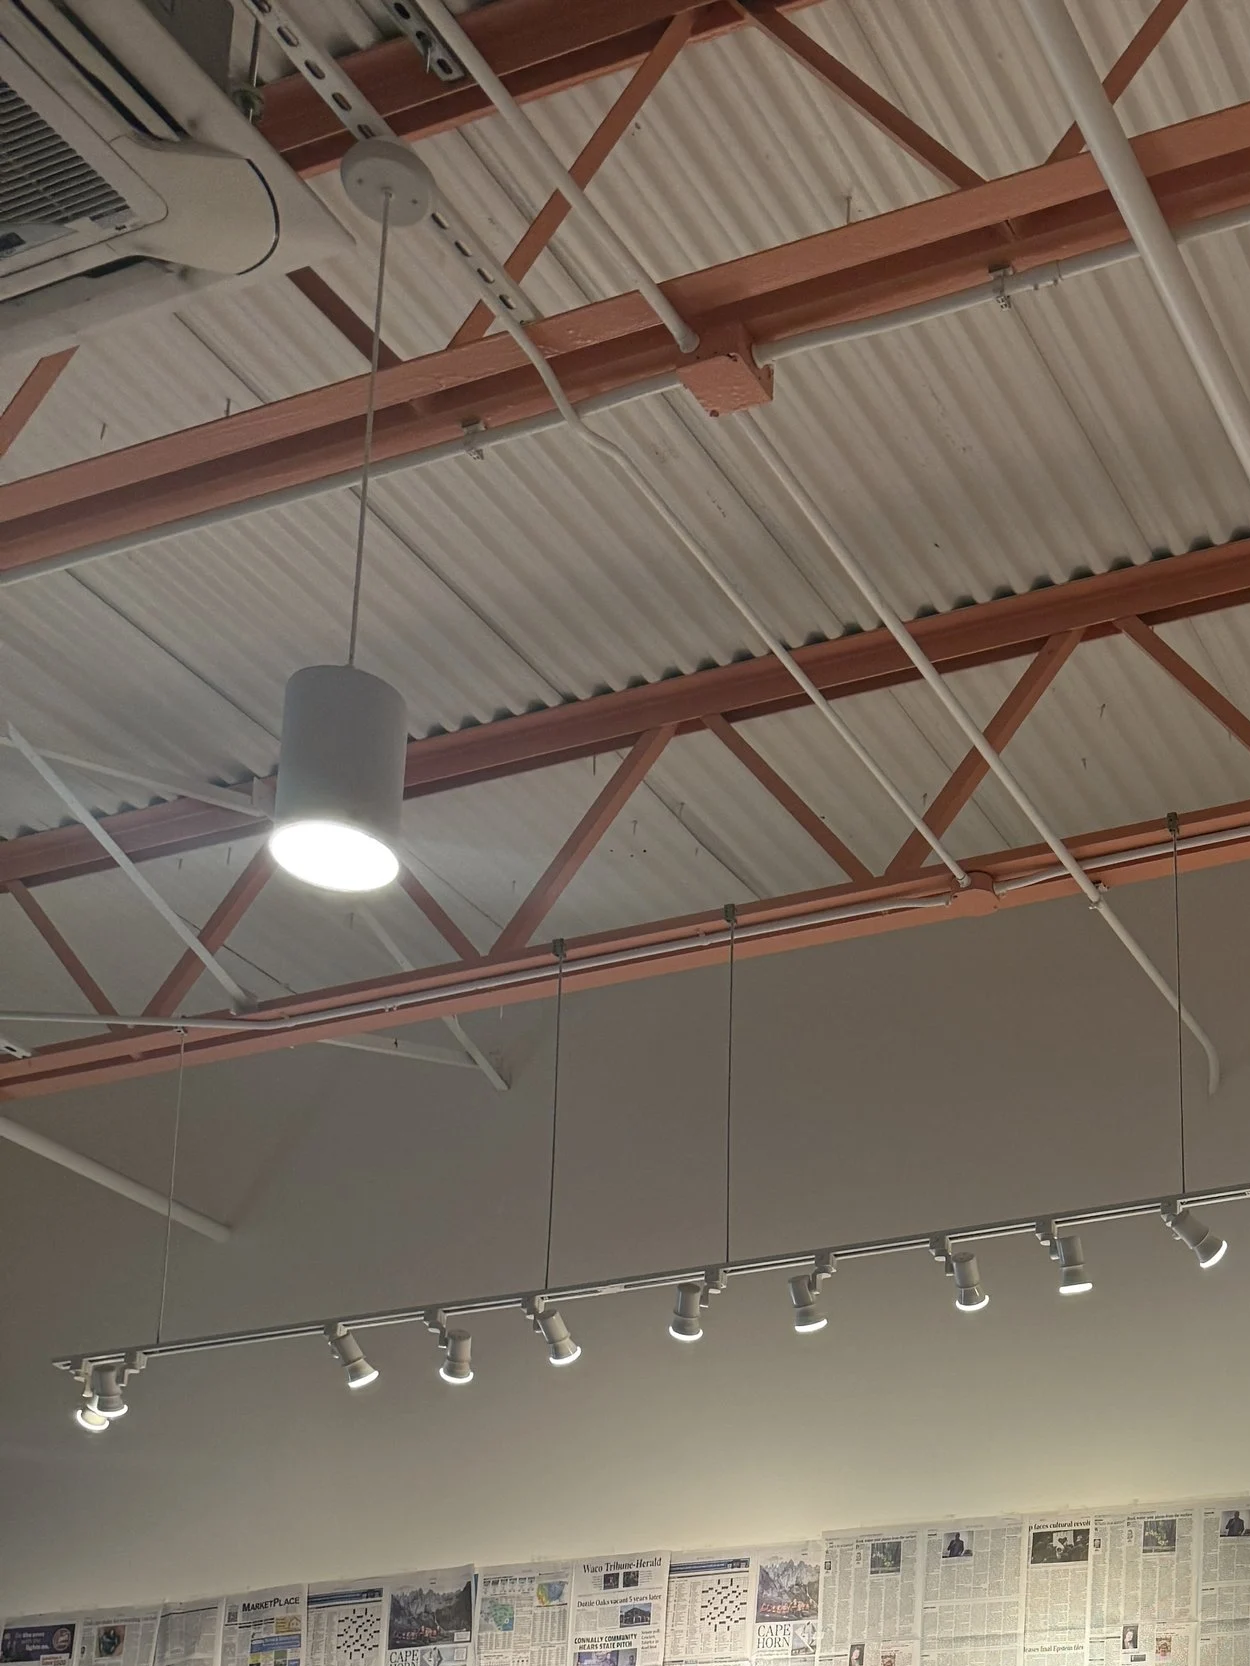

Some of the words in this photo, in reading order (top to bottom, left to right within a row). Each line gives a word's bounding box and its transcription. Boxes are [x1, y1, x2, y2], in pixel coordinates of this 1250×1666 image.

[582, 1562, 603, 1574] Waco
[605, 1557, 662, 1572] Tribune-Herald
[242, 1597, 300, 1612] MARKETPLACE
[757, 1624, 791, 1638] CAPE
[757, 1637, 791, 1649] HORN
[389, 1649, 419, 1664] CAPE
